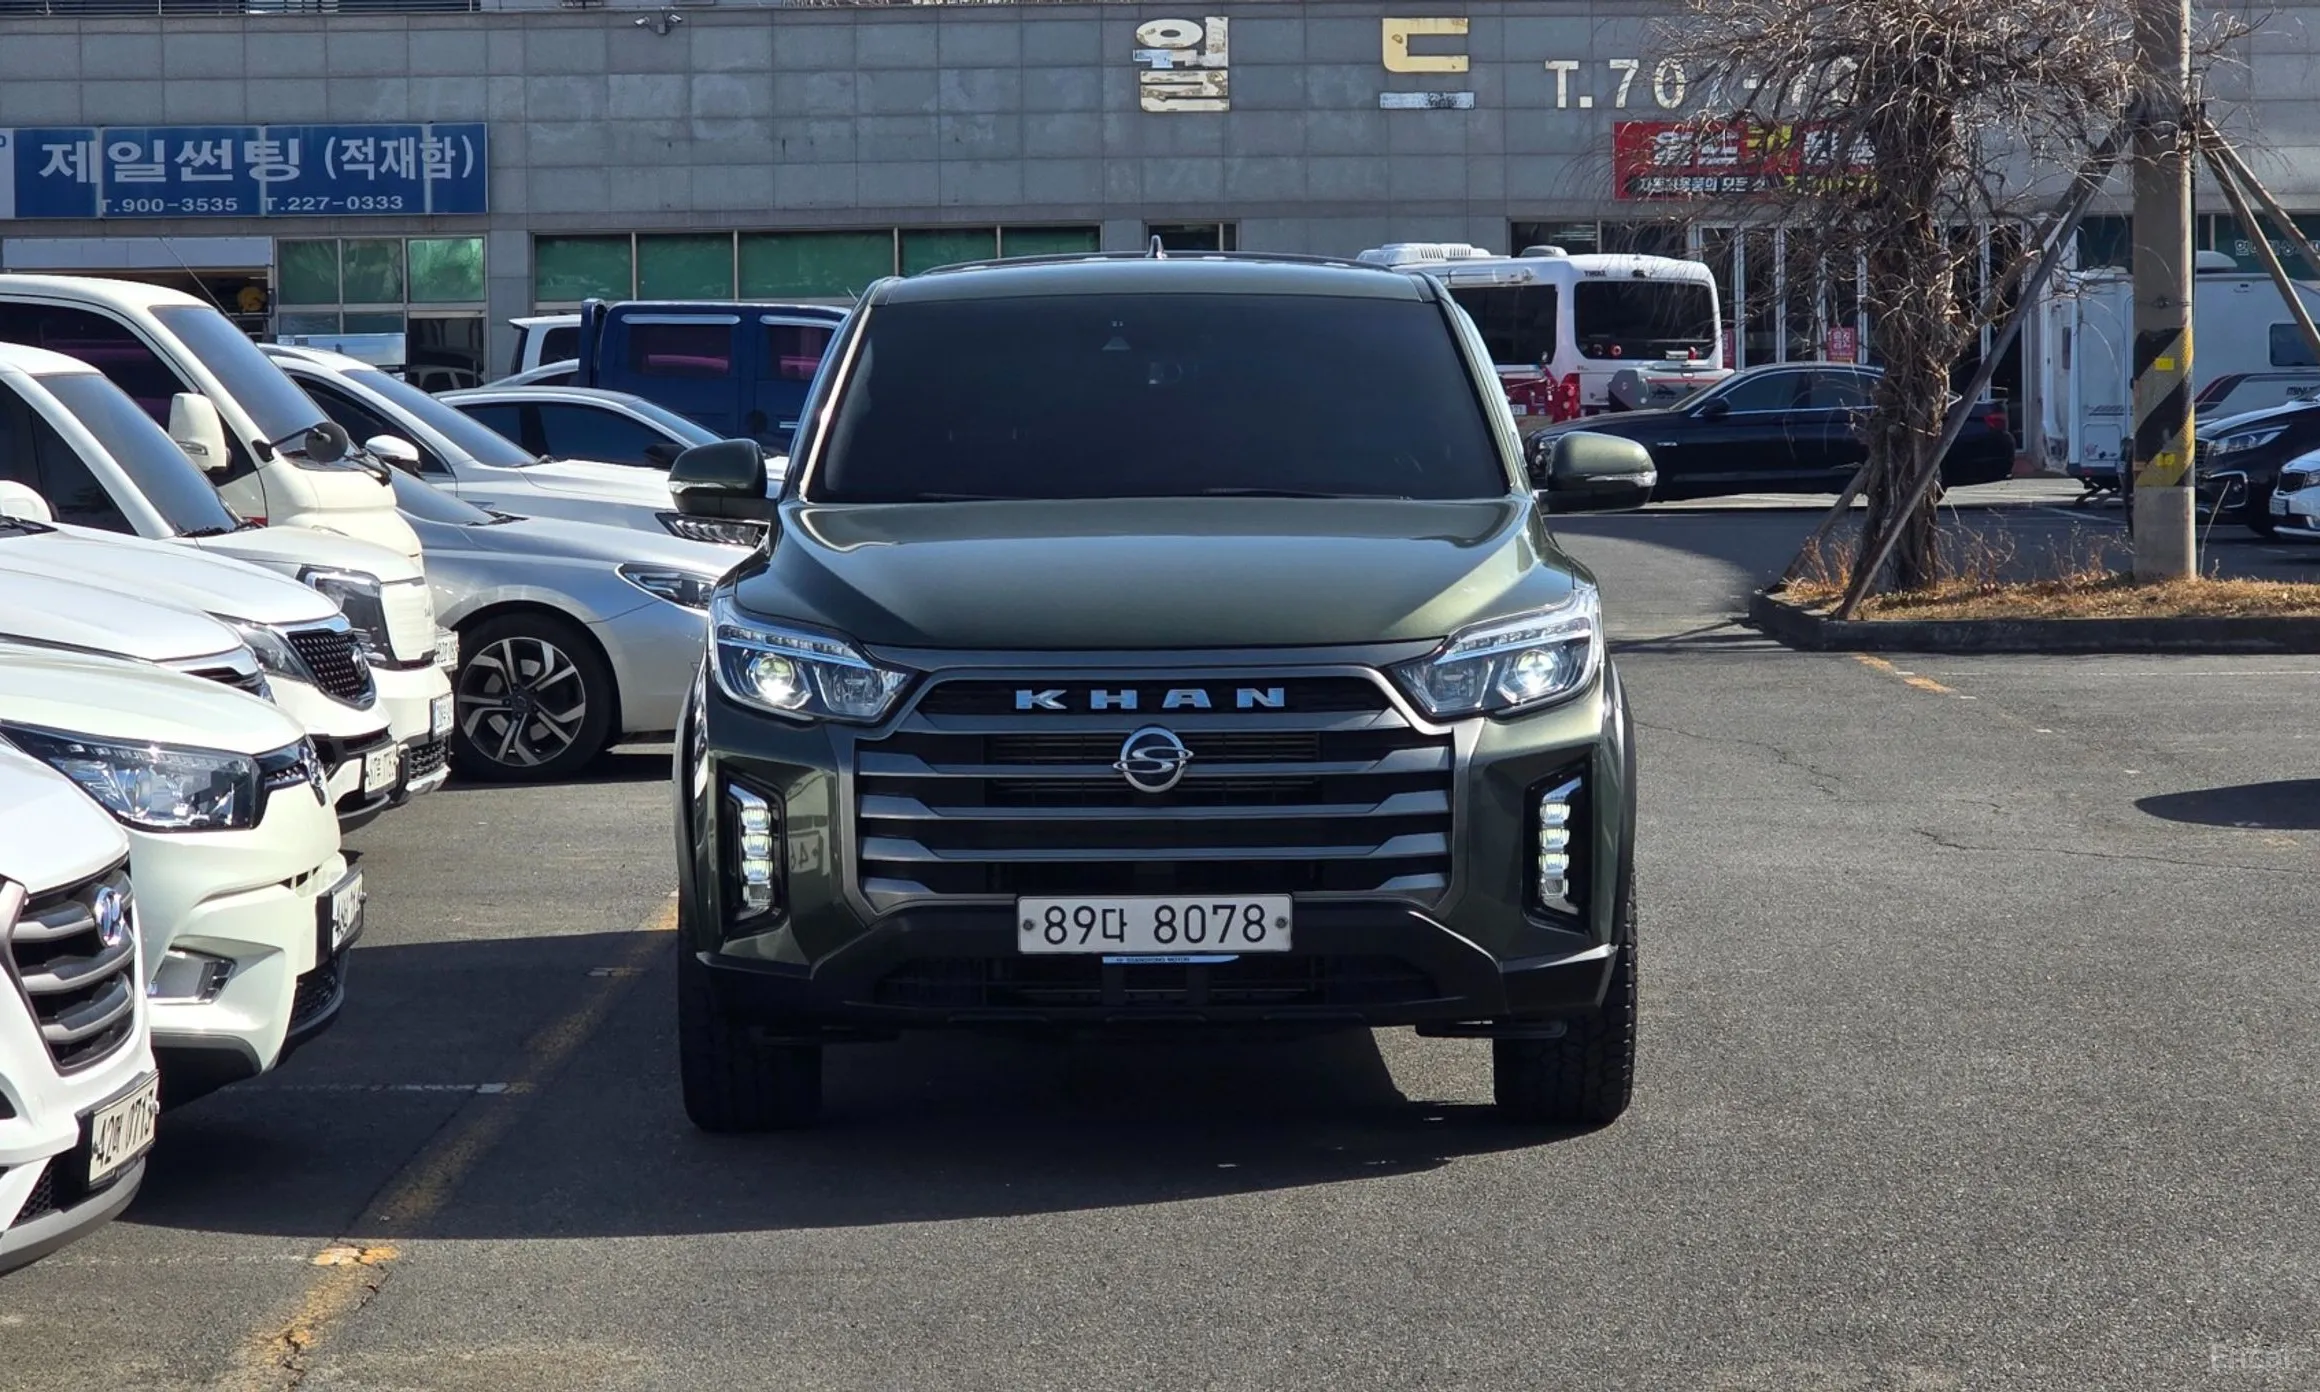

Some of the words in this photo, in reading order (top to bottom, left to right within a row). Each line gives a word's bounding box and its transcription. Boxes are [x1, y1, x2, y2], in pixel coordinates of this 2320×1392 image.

[38, 138, 300, 183] 제일썬팅
[324, 135, 474, 181] (적재함)
[100, 197, 238, 213] T.900-3535
[265, 195, 404, 211] T.227-0333
[1015, 687, 1285, 710] KHAN
[1044, 905, 1128, 945] 89다
[1153, 903, 1267, 944] 8078
